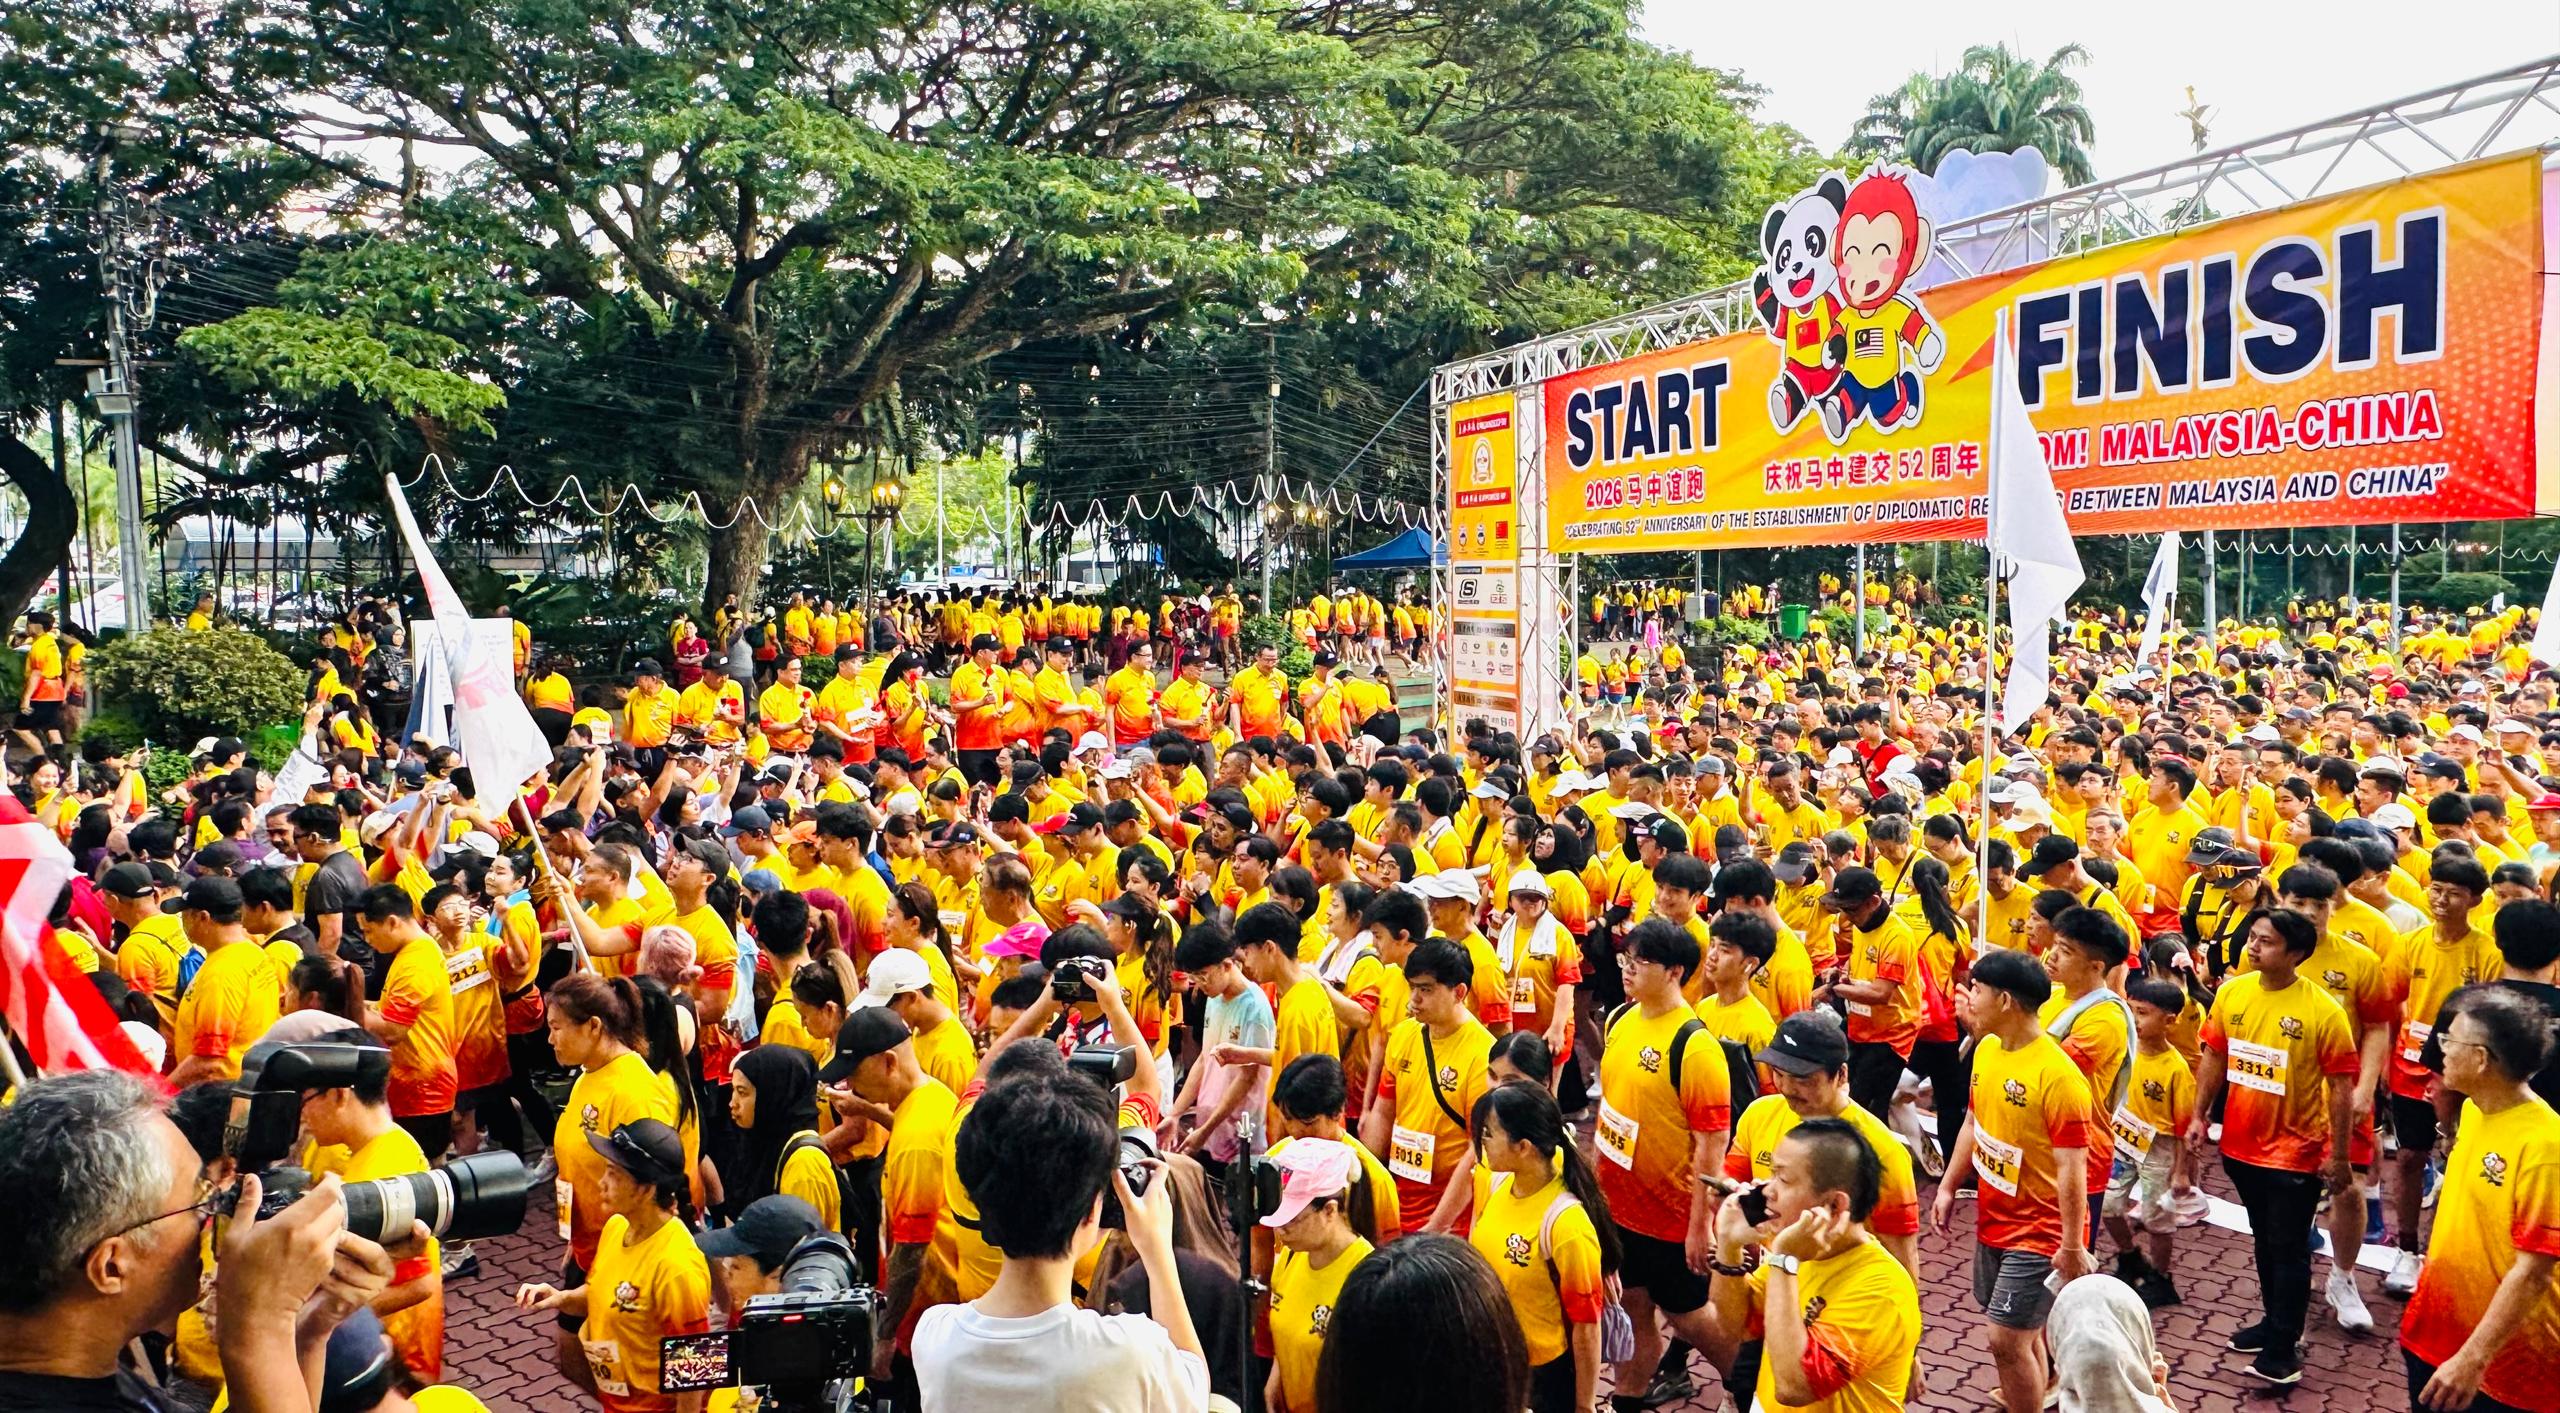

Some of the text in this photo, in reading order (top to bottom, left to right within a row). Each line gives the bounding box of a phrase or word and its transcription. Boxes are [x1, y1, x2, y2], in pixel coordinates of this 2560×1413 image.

[2017, 215, 2440, 406] FINISH
[1567, 362, 1728, 468] START
[2103, 394, 2440, 463] MALAYSIA-CHINA
[1586, 480, 1623, 508] 2026
[1899, 450, 1924, 480] 52
[1930, 443, 1980, 479] 周年
[1644, 514, 1707, 532] ANNIVERSARY
[1711, 513, 1725, 529] OF
[1729, 511, 1749, 529] THE
[1753, 505, 1850, 527] ESTABLISHMENT
[1854, 504, 1872, 522] OF
[1877, 498, 1964, 519] DIPLOMATIC
[2070, 486, 2161, 511] BETWEEN
[2169, 478, 2276, 506] MALAYSIA
[2284, 474, 2337, 499] AND
[2349, 465, 2446, 495] CHINA”
[2236, 1058, 2275, 1080] 3314
